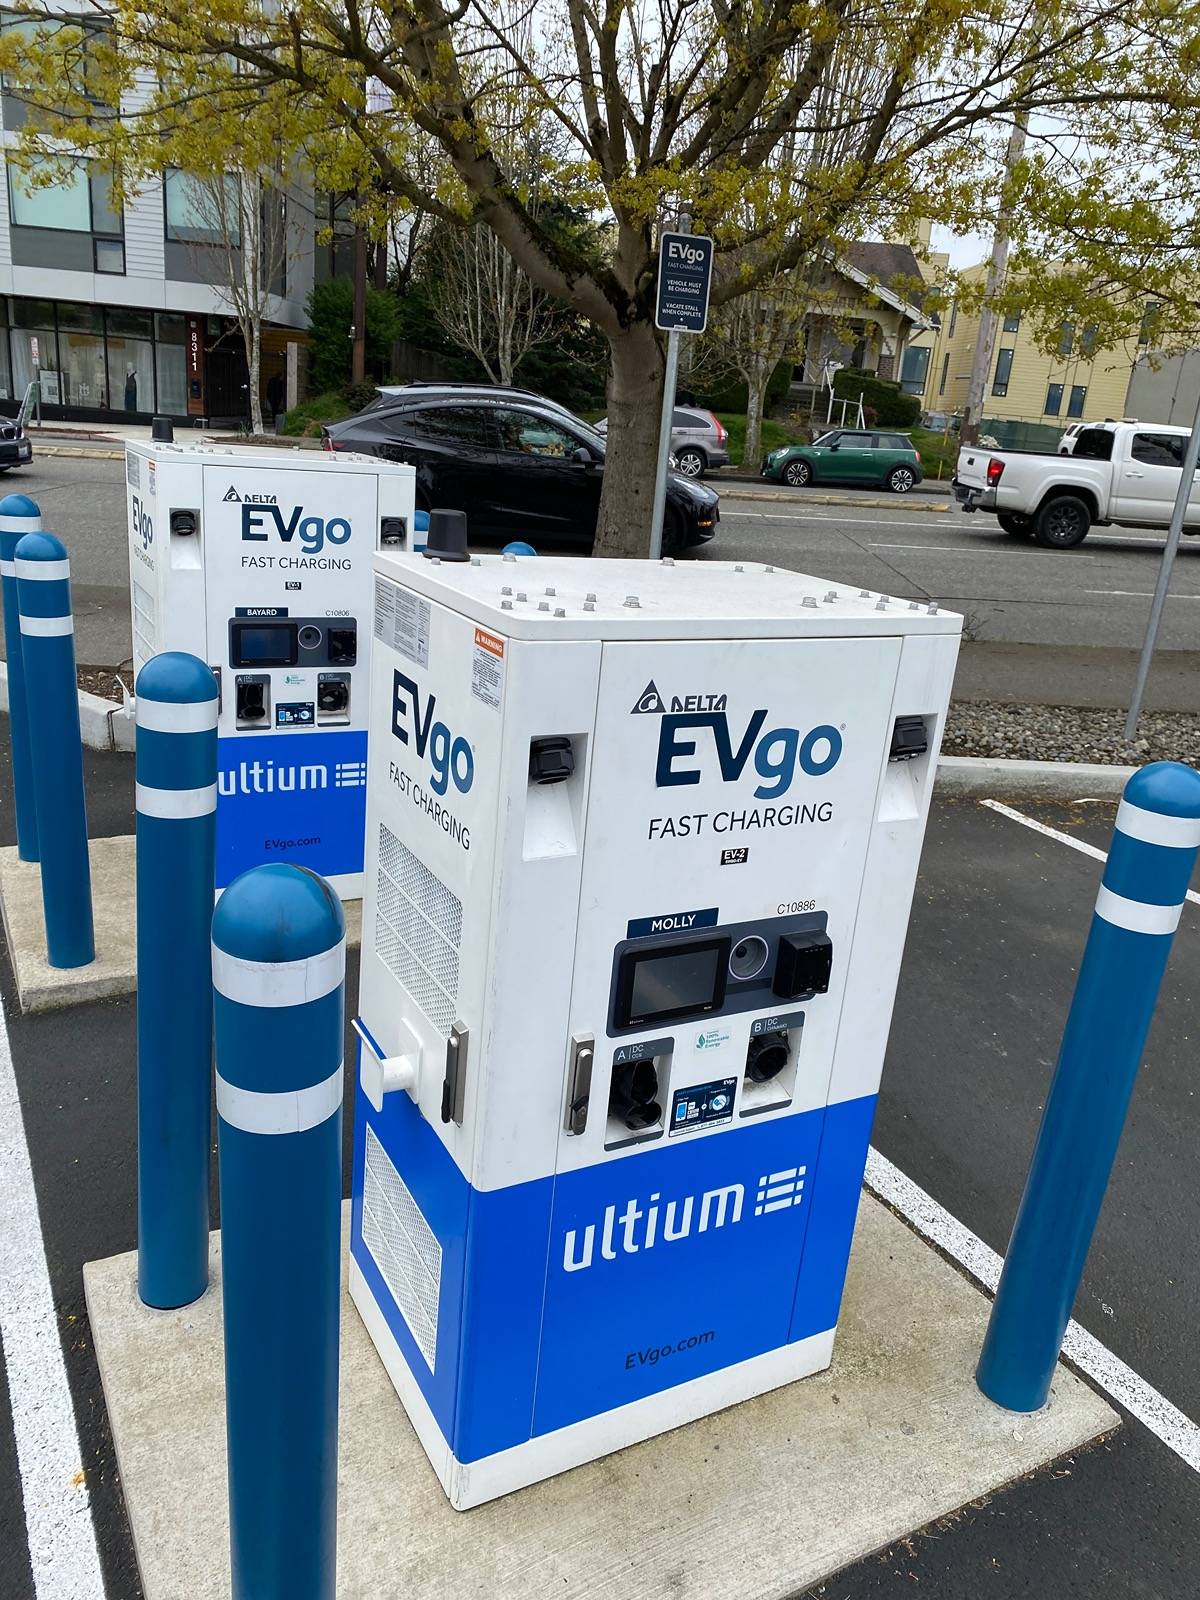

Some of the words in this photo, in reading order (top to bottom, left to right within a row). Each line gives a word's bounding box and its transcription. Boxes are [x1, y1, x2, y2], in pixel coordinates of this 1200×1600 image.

[668, 242, 705, 264] EVgo
[680, 263, 704, 272] CHARGING
[675, 286, 700, 295] CHARGING
[666, 302, 685, 310] VACATE
[677, 310, 702, 318] COMPLETE
[244, 494, 277, 504] DELTA
[132, 495, 153, 550] EVgo
[242, 503, 352, 554] EVgo
[241, 556, 276, 568] FAST
[278, 557, 352, 570] CHARGING
[480, 635, 503, 653] WARNING
[670, 694, 727, 713] DELTA
[392, 668, 474, 796] EVgo
[656, 709, 843, 800] EVgo
[218, 760, 327, 796] ultium
[389, 761, 412, 796] FAST
[412, 784, 471, 850] CHARGING
[648, 813, 708, 839] FAST
[712, 802, 833, 833] CHARGING
[264, 836, 321, 850] EVgo.com
[724, 849, 745, 859] EV-2
[777, 900, 816, 915] C10886
[651, 914, 696, 932] MOLLY
[754, 1022, 761, 1032] B
[767, 1017, 778, 1026] DC
[618, 1050, 625, 1060] A
[632, 1044, 644, 1053] DC
[562, 1183, 745, 1273] ultium
[624, 1330, 716, 1371] EVgo.com
